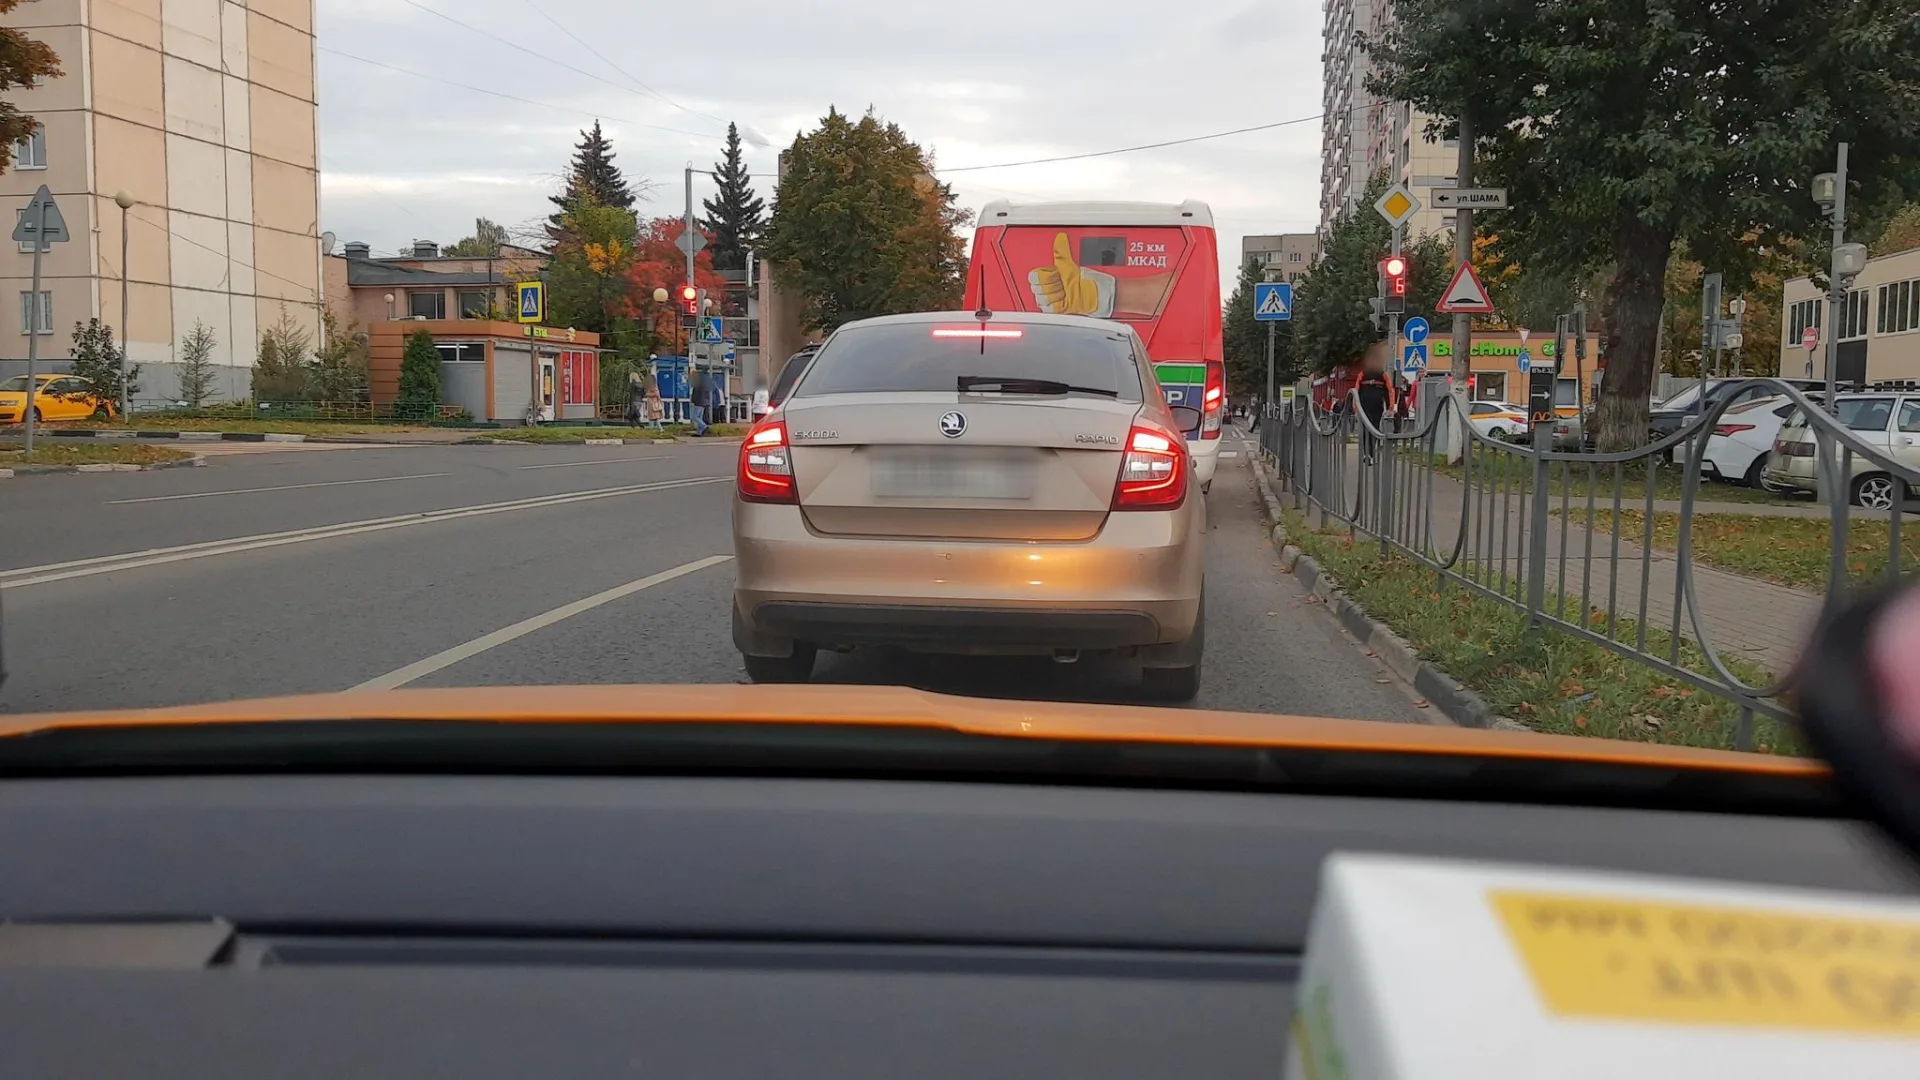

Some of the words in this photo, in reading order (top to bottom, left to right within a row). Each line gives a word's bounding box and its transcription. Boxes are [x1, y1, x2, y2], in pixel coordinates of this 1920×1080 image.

[1456, 194, 1500, 204] ул.ШАМА
[1129, 242, 1144, 252] 25
[1146, 244, 1165, 252] км
[1127, 256, 1166, 268] МКАД
[1396, 277, 1404, 293] 6
[690, 301, 697, 313] 6
[523, 326, 548, 338] ЦЕТЫ
[1074, 433, 1119, 445] RAPID
